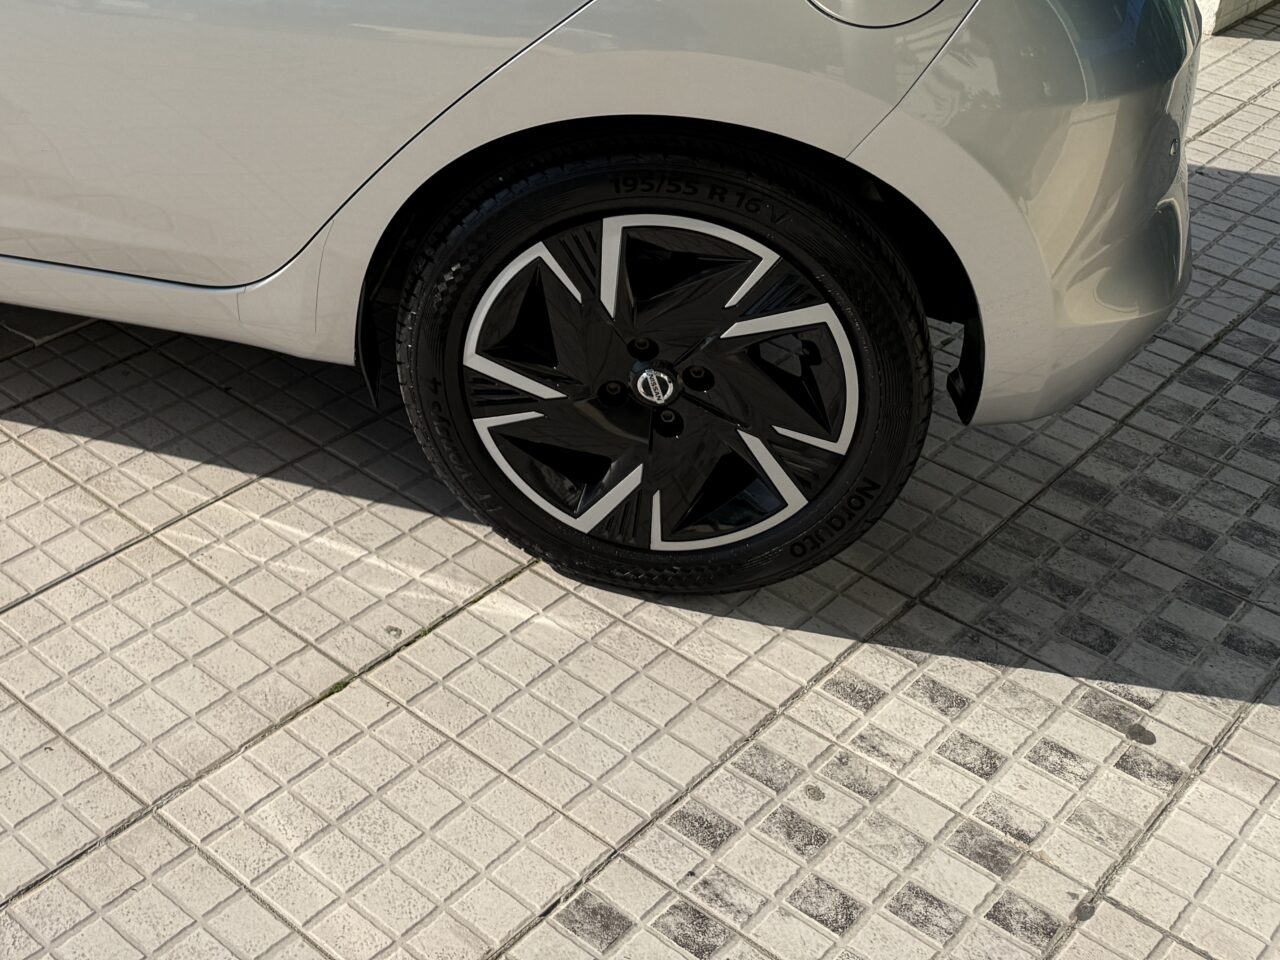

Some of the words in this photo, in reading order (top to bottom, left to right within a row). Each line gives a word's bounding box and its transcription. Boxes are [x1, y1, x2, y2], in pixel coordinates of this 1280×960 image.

[609, 174, 700, 195] 195/55
[708, 184, 729, 203] R
[735, 191, 763, 214] 16
[648, 373, 663, 401] NISSAN
